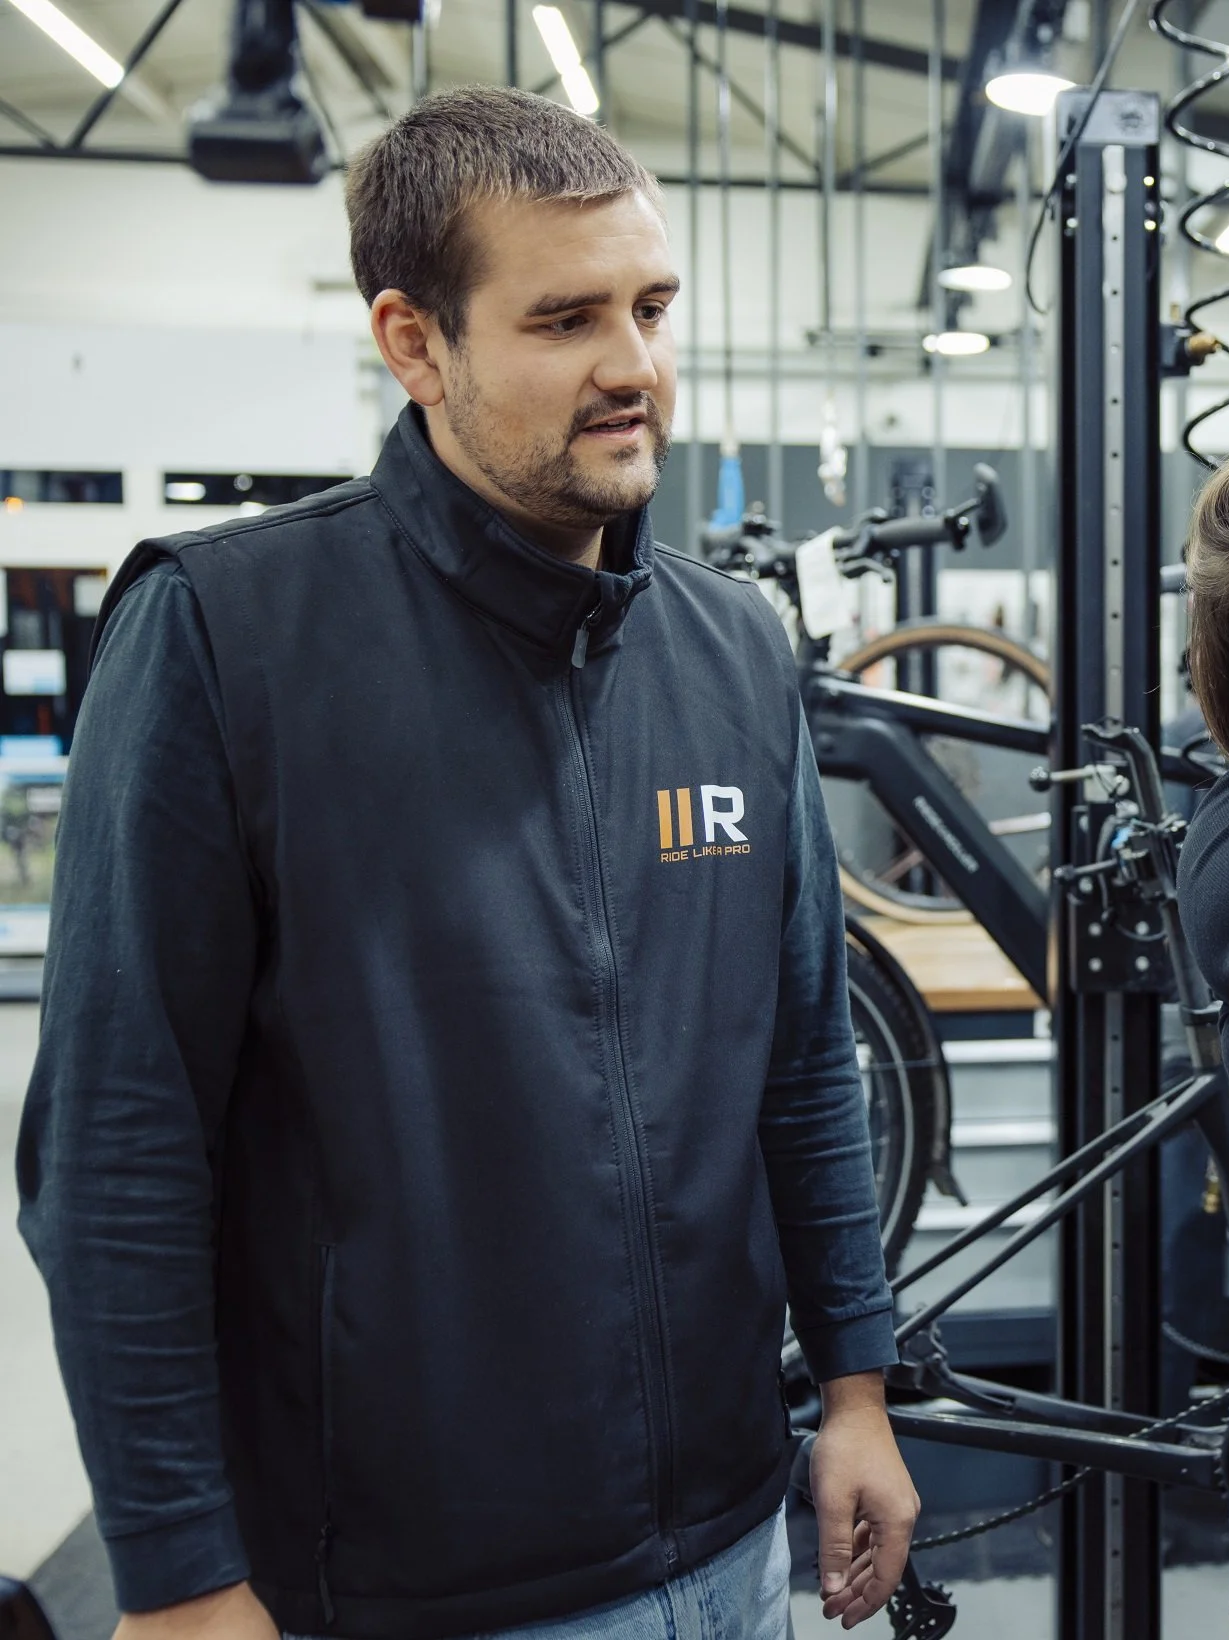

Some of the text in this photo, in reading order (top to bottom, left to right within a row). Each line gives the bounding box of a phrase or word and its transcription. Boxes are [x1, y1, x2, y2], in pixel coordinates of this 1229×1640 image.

[660, 850, 689, 863] RIDE
[693, 846, 717, 858] LIKE
[724, 844, 751, 856] PRO
